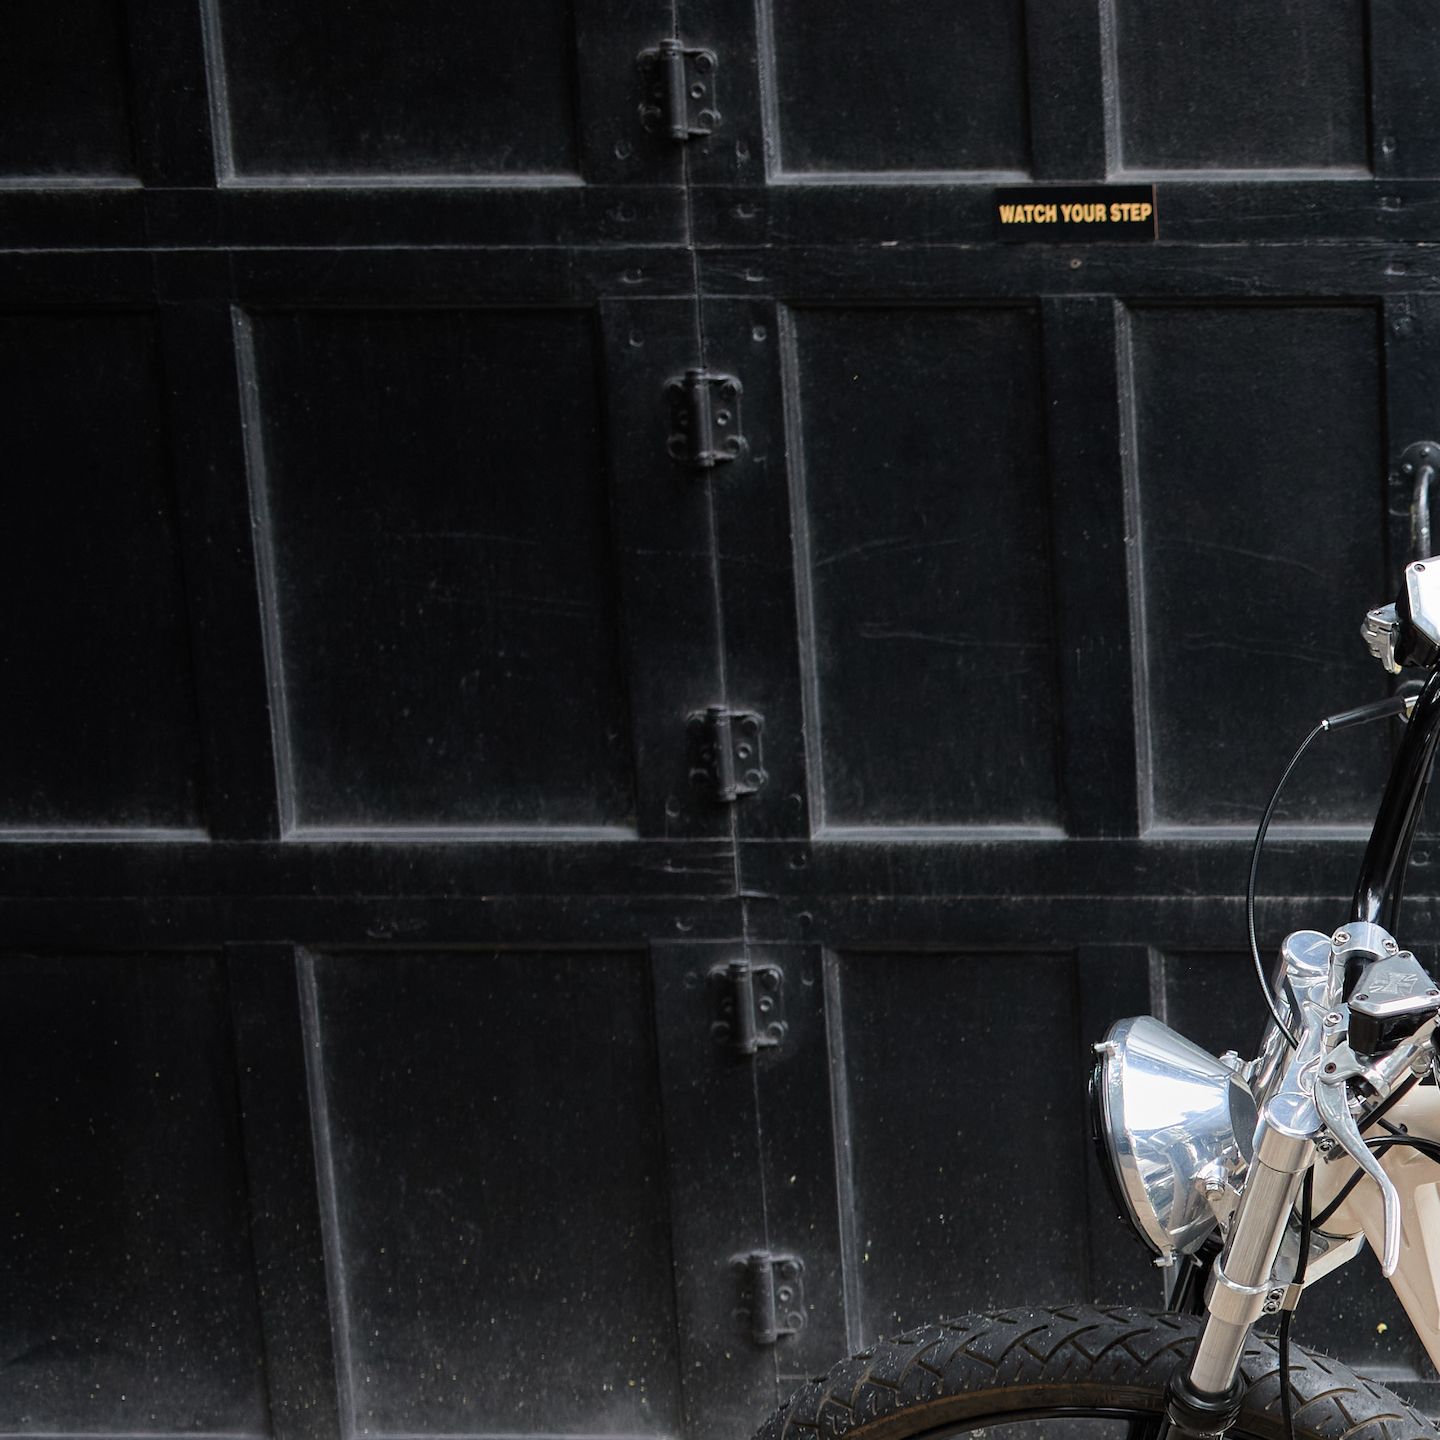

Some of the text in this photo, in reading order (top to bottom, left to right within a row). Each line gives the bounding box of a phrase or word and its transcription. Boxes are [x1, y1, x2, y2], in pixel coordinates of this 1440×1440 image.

[999, 203, 1152, 224] WATCH YOUR STEP
